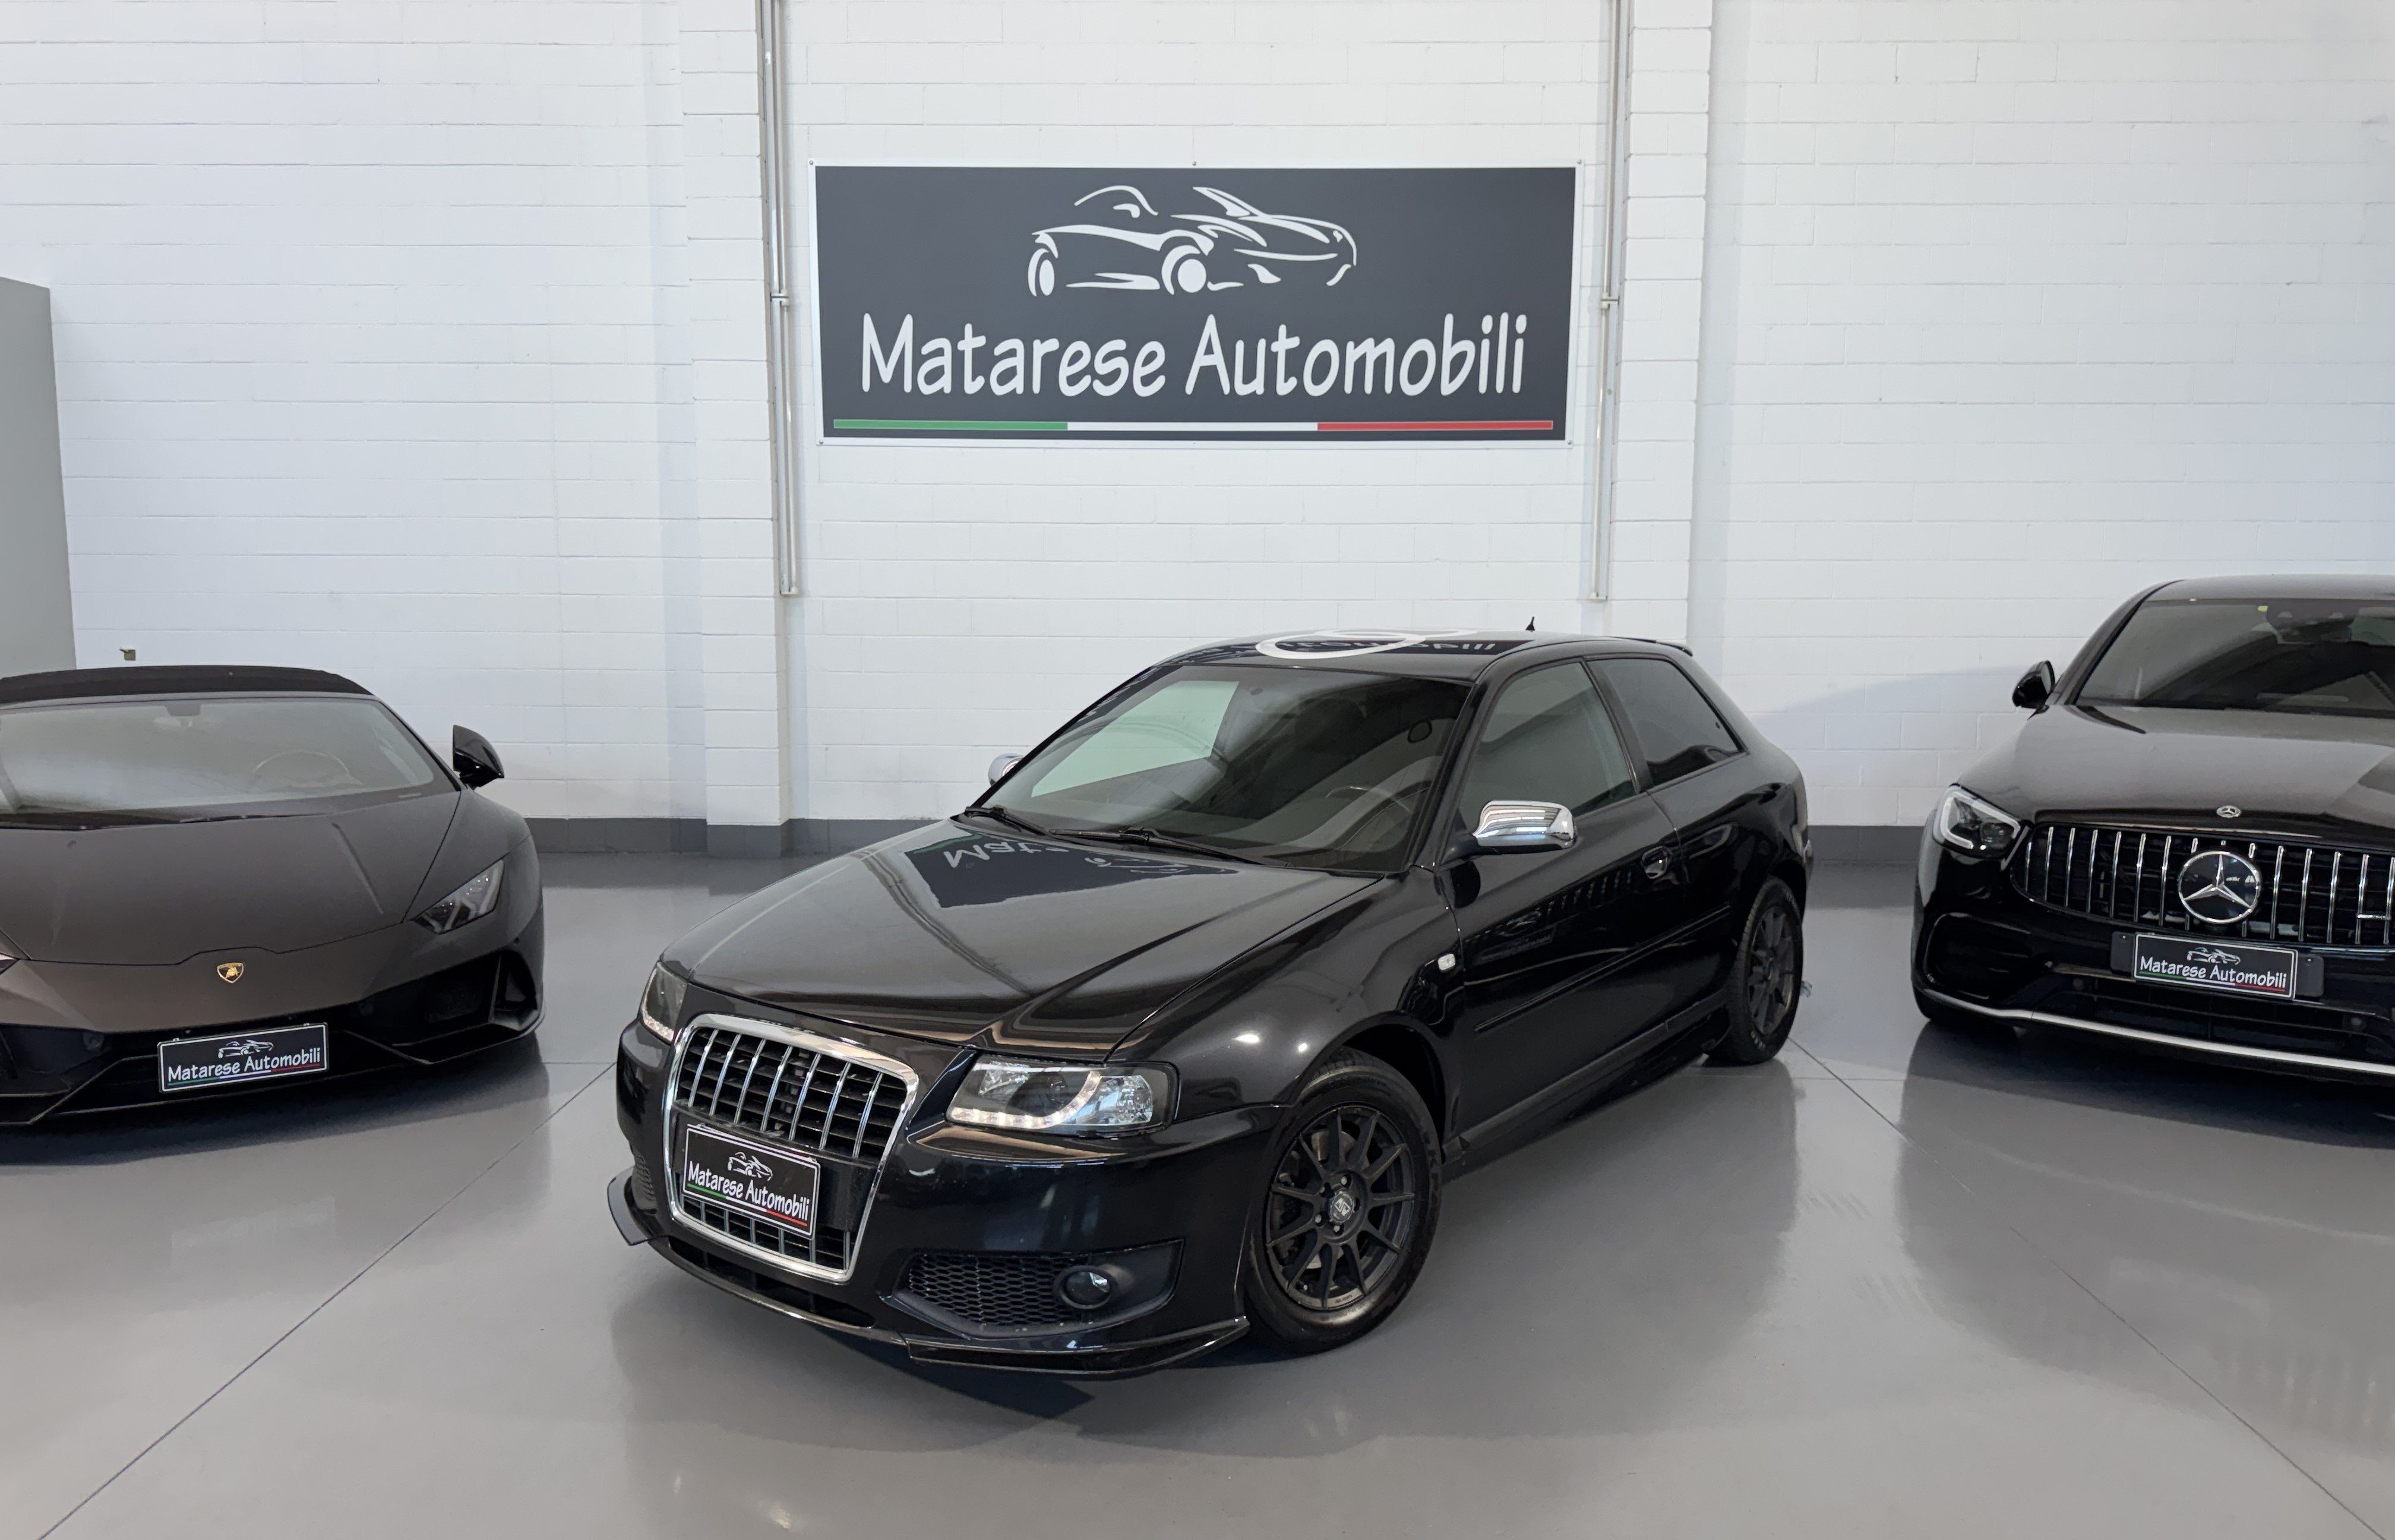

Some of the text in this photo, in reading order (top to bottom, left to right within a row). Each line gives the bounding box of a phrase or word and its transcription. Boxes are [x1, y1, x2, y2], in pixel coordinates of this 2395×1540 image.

[862, 312, 1527, 397] Matarese Automobili
[2141, 956, 2286, 988] Matarese Automobili
[168, 1047, 320, 1082] Matarese Automobili
[688, 1160, 810, 1220] Matarese Automobili
